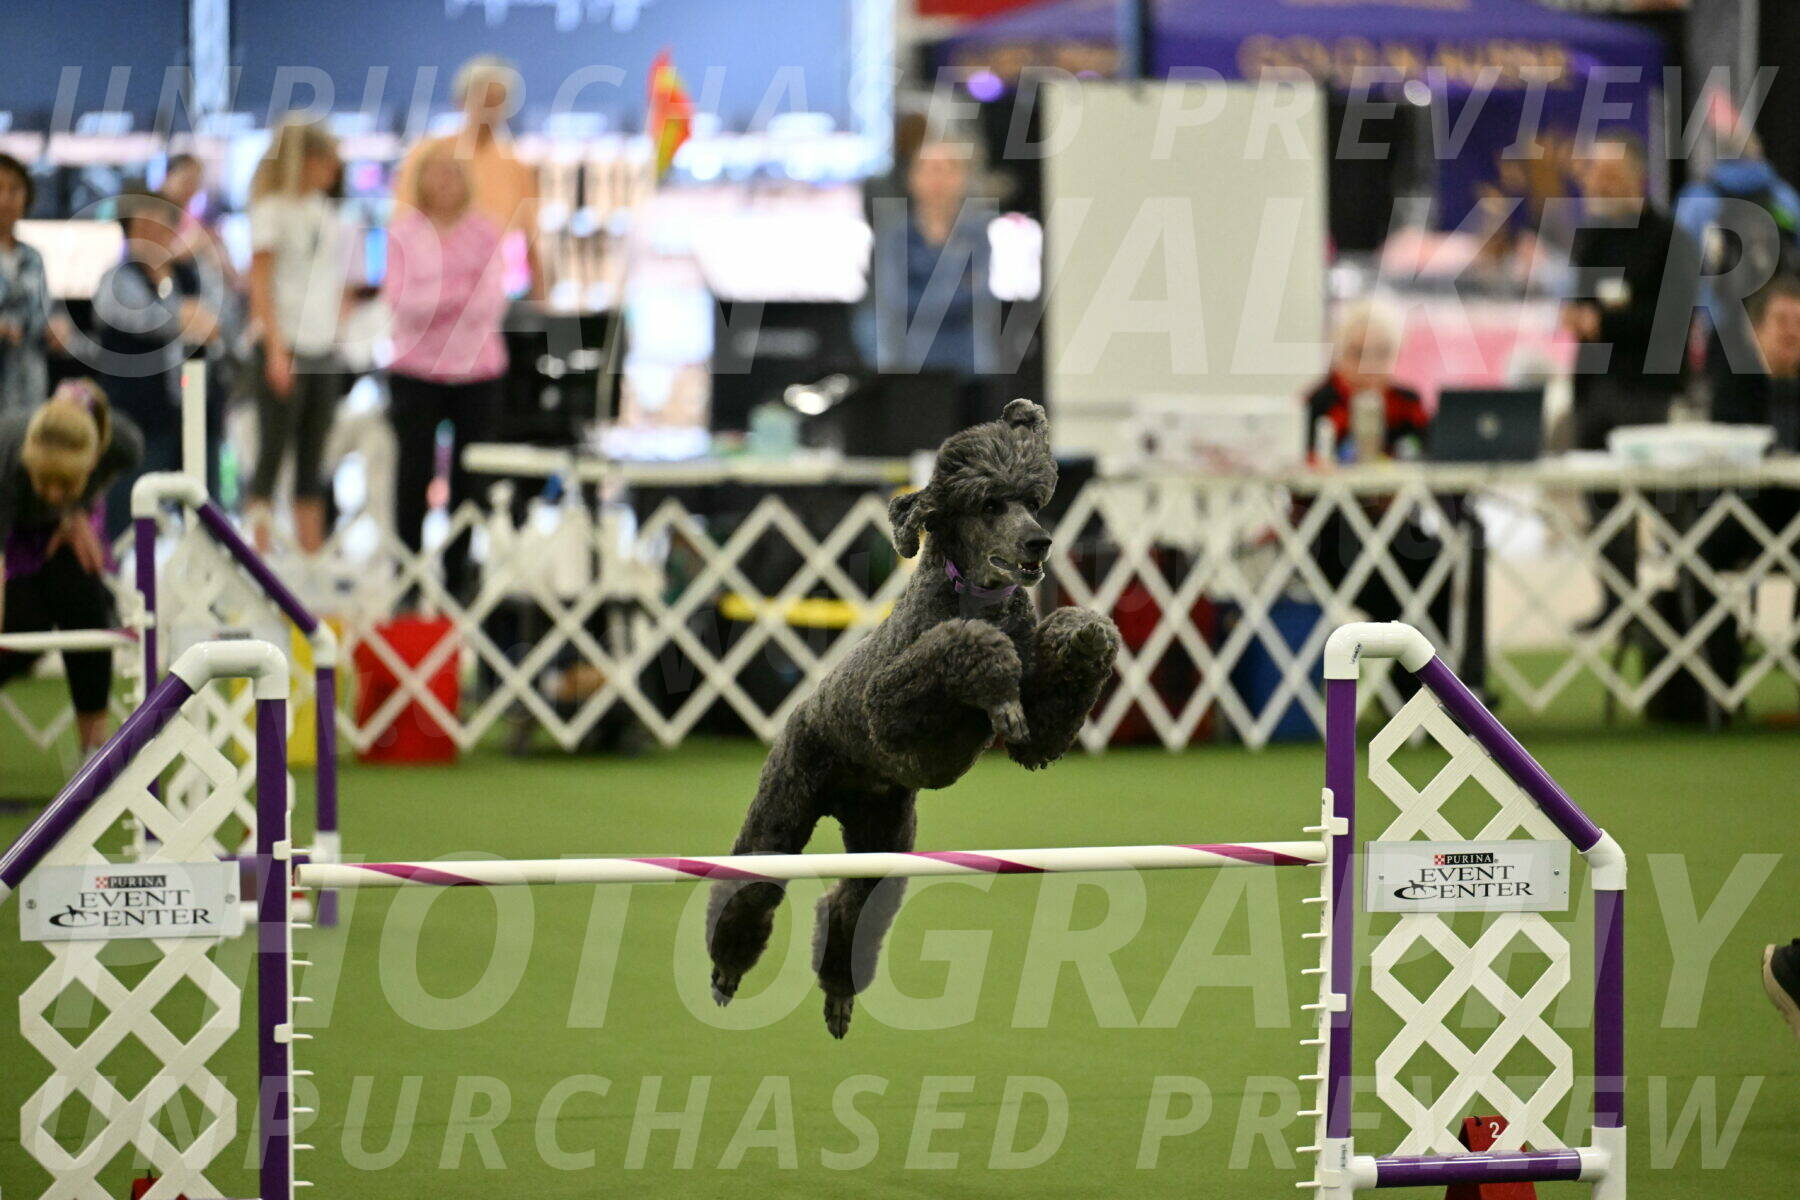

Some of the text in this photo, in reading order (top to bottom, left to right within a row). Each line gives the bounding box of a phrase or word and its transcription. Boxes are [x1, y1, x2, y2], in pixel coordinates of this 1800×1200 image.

[1447, 854, 1493, 865] PURINA
[109, 876, 166, 888] PURINA
[1420, 866, 1514, 883] EVENT
[79, 890, 190, 908] EVENT
[1394, 882, 1534, 900] CENTER
[49, 909, 213, 928] CENTER
[1489, 1122, 1501, 1139] 2
